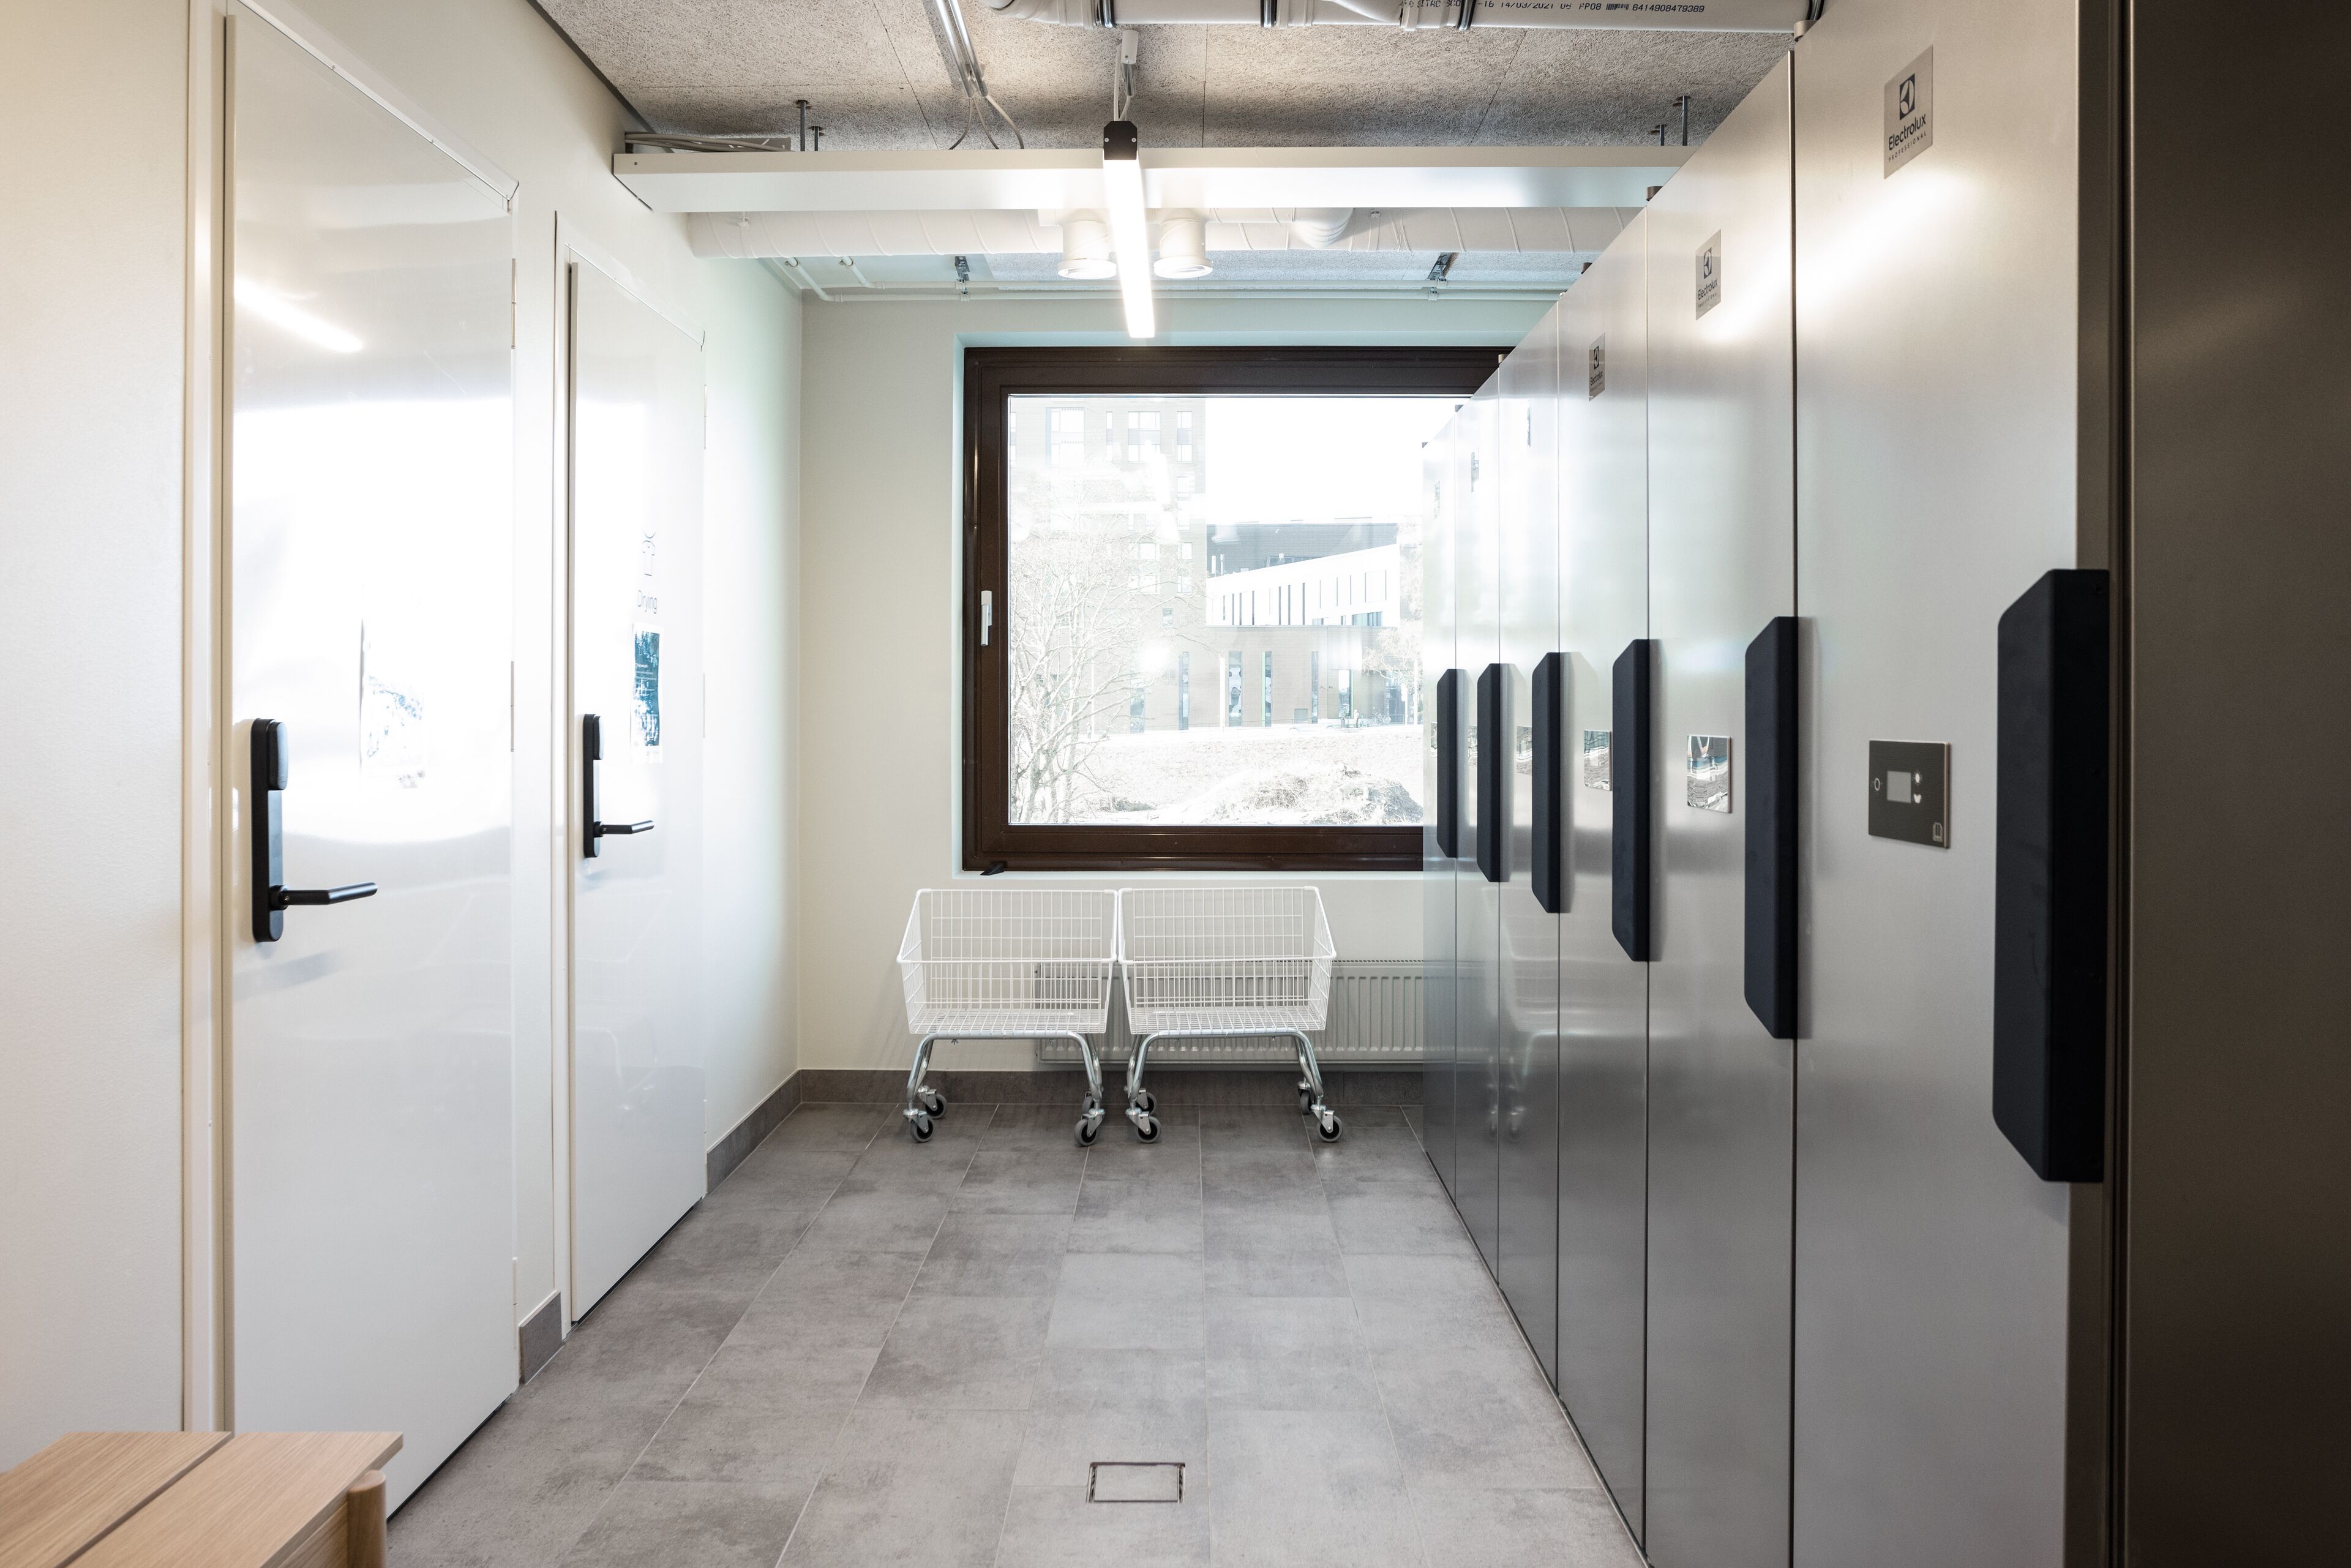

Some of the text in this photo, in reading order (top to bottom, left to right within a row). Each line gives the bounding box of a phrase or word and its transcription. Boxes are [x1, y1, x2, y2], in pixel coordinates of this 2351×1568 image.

[1632, 3, 1705, 13] 6414908479389
[1889, 113, 1927, 151] Electrolux
[1888, 130, 1927, 163] PROFESSIONAL
[1698, 278, 1719, 301] Electrolux
[637, 589, 658, 614] Drying
